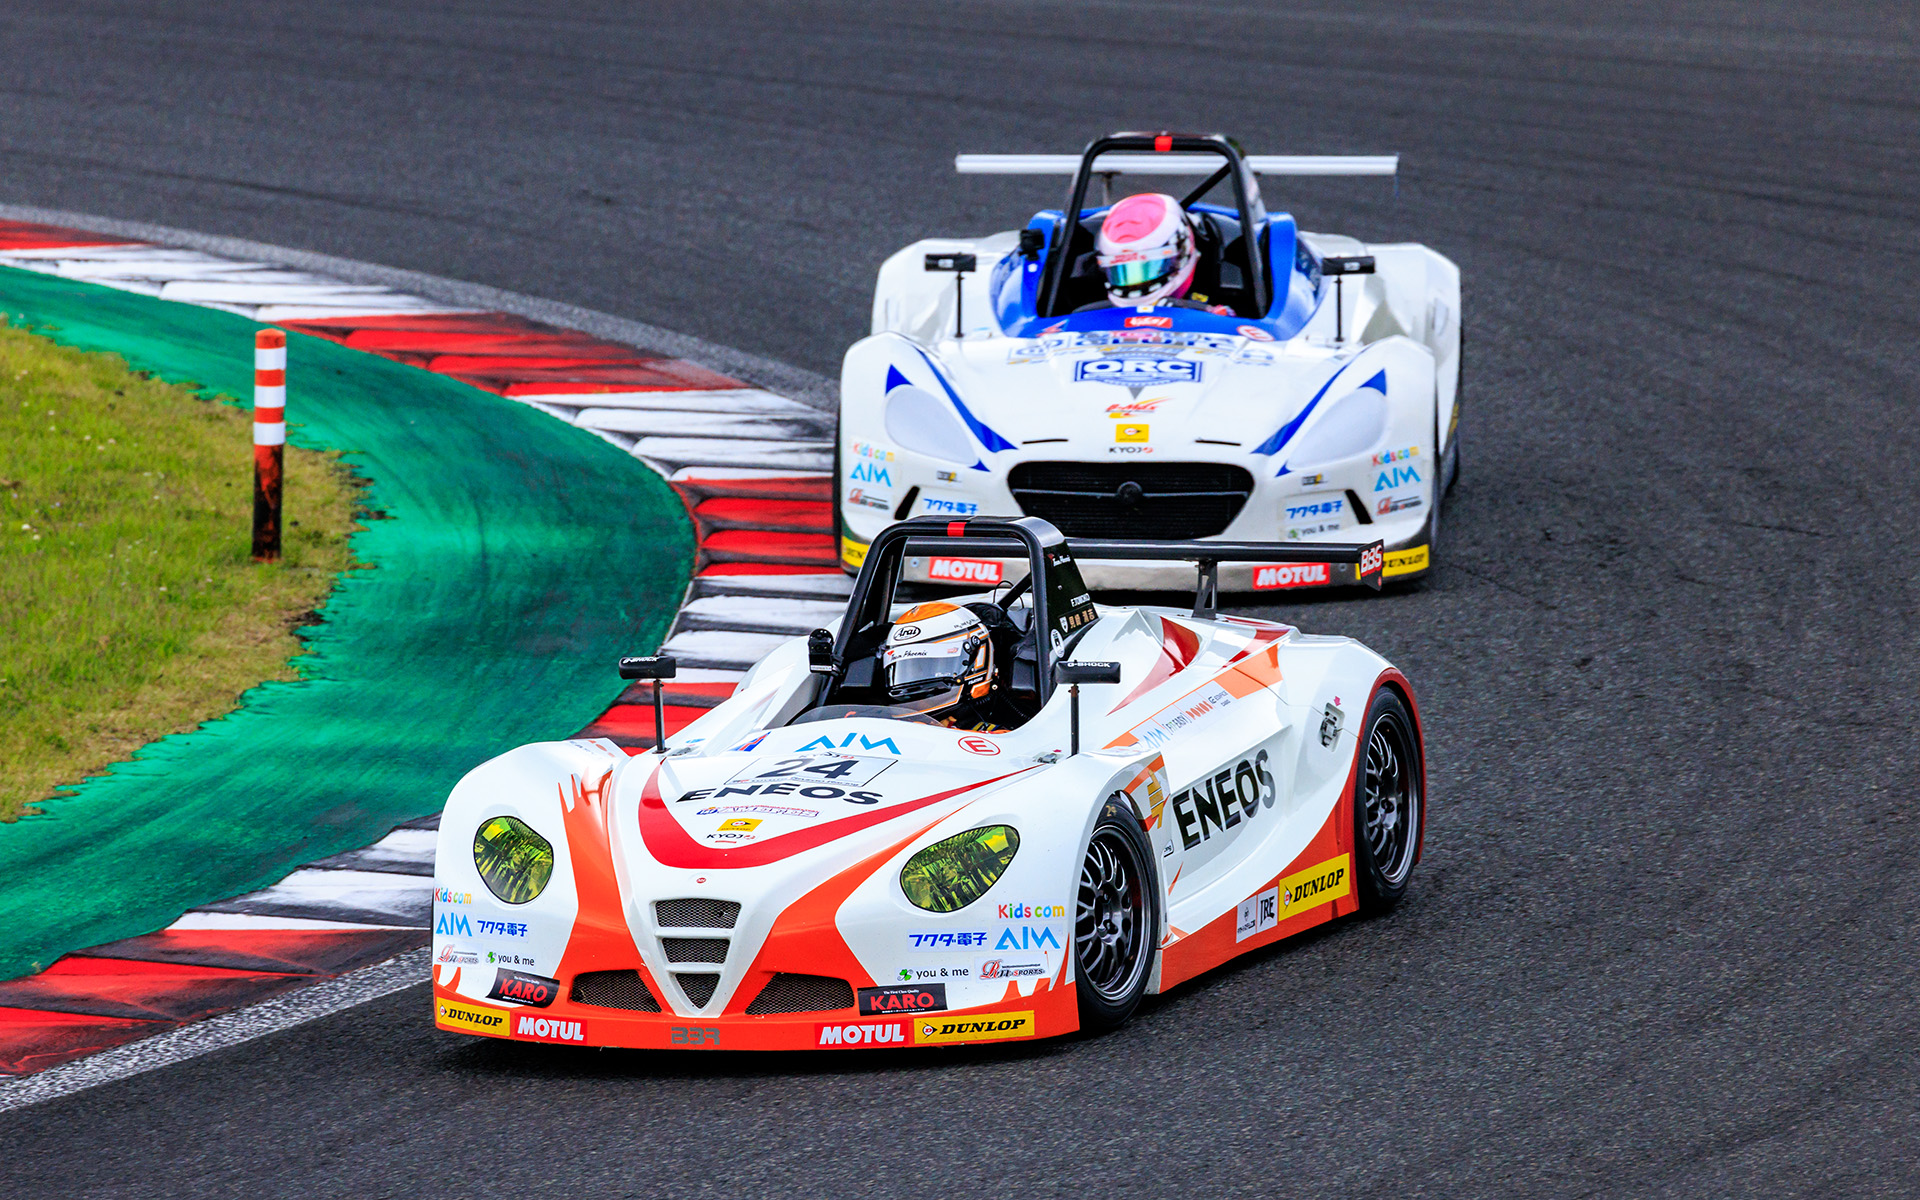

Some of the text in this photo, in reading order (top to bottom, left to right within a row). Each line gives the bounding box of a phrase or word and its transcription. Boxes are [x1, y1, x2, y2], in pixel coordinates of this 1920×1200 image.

[1084, 360, 1194, 373] ORC
[850, 462, 892, 488] AIM
[1374, 466, 1421, 492] AIM
[1301, 526, 1316, 536] you
[1328, 523, 1340, 531] me
[931, 559, 999, 581] MOTUL
[1361, 544, 1382, 577] BBS
[1256, 565, 1327, 587] MOTUL
[899, 626, 917, 637] Arai
[796, 732, 901, 755] AIM
[755, 758, 860, 779] 24
[676, 782, 883, 805] ENEOS
[1173, 749, 1276, 851] ENEOS
[435, 887, 472, 904] Kids com
[1293, 868, 1344, 903] DUNLOP
[998, 903, 1065, 919] Kids com
[436, 912, 472, 937] AIM
[477, 920, 528, 937] フクダ電子
[909, 931, 988, 947] フクダ電子
[994, 926, 1060, 950] AIM
[498, 954, 534, 966] you & me
[916, 967, 969, 979] you & me
[499, 977, 548, 1002] KARO
[870, 992, 935, 1010] KARO
[448, 1008, 503, 1027] DUNLOP
[940, 1019, 1026, 1035] DUNLOP
[518, 1016, 584, 1041] MOTUL
[819, 1024, 905, 1045] MOTUL
